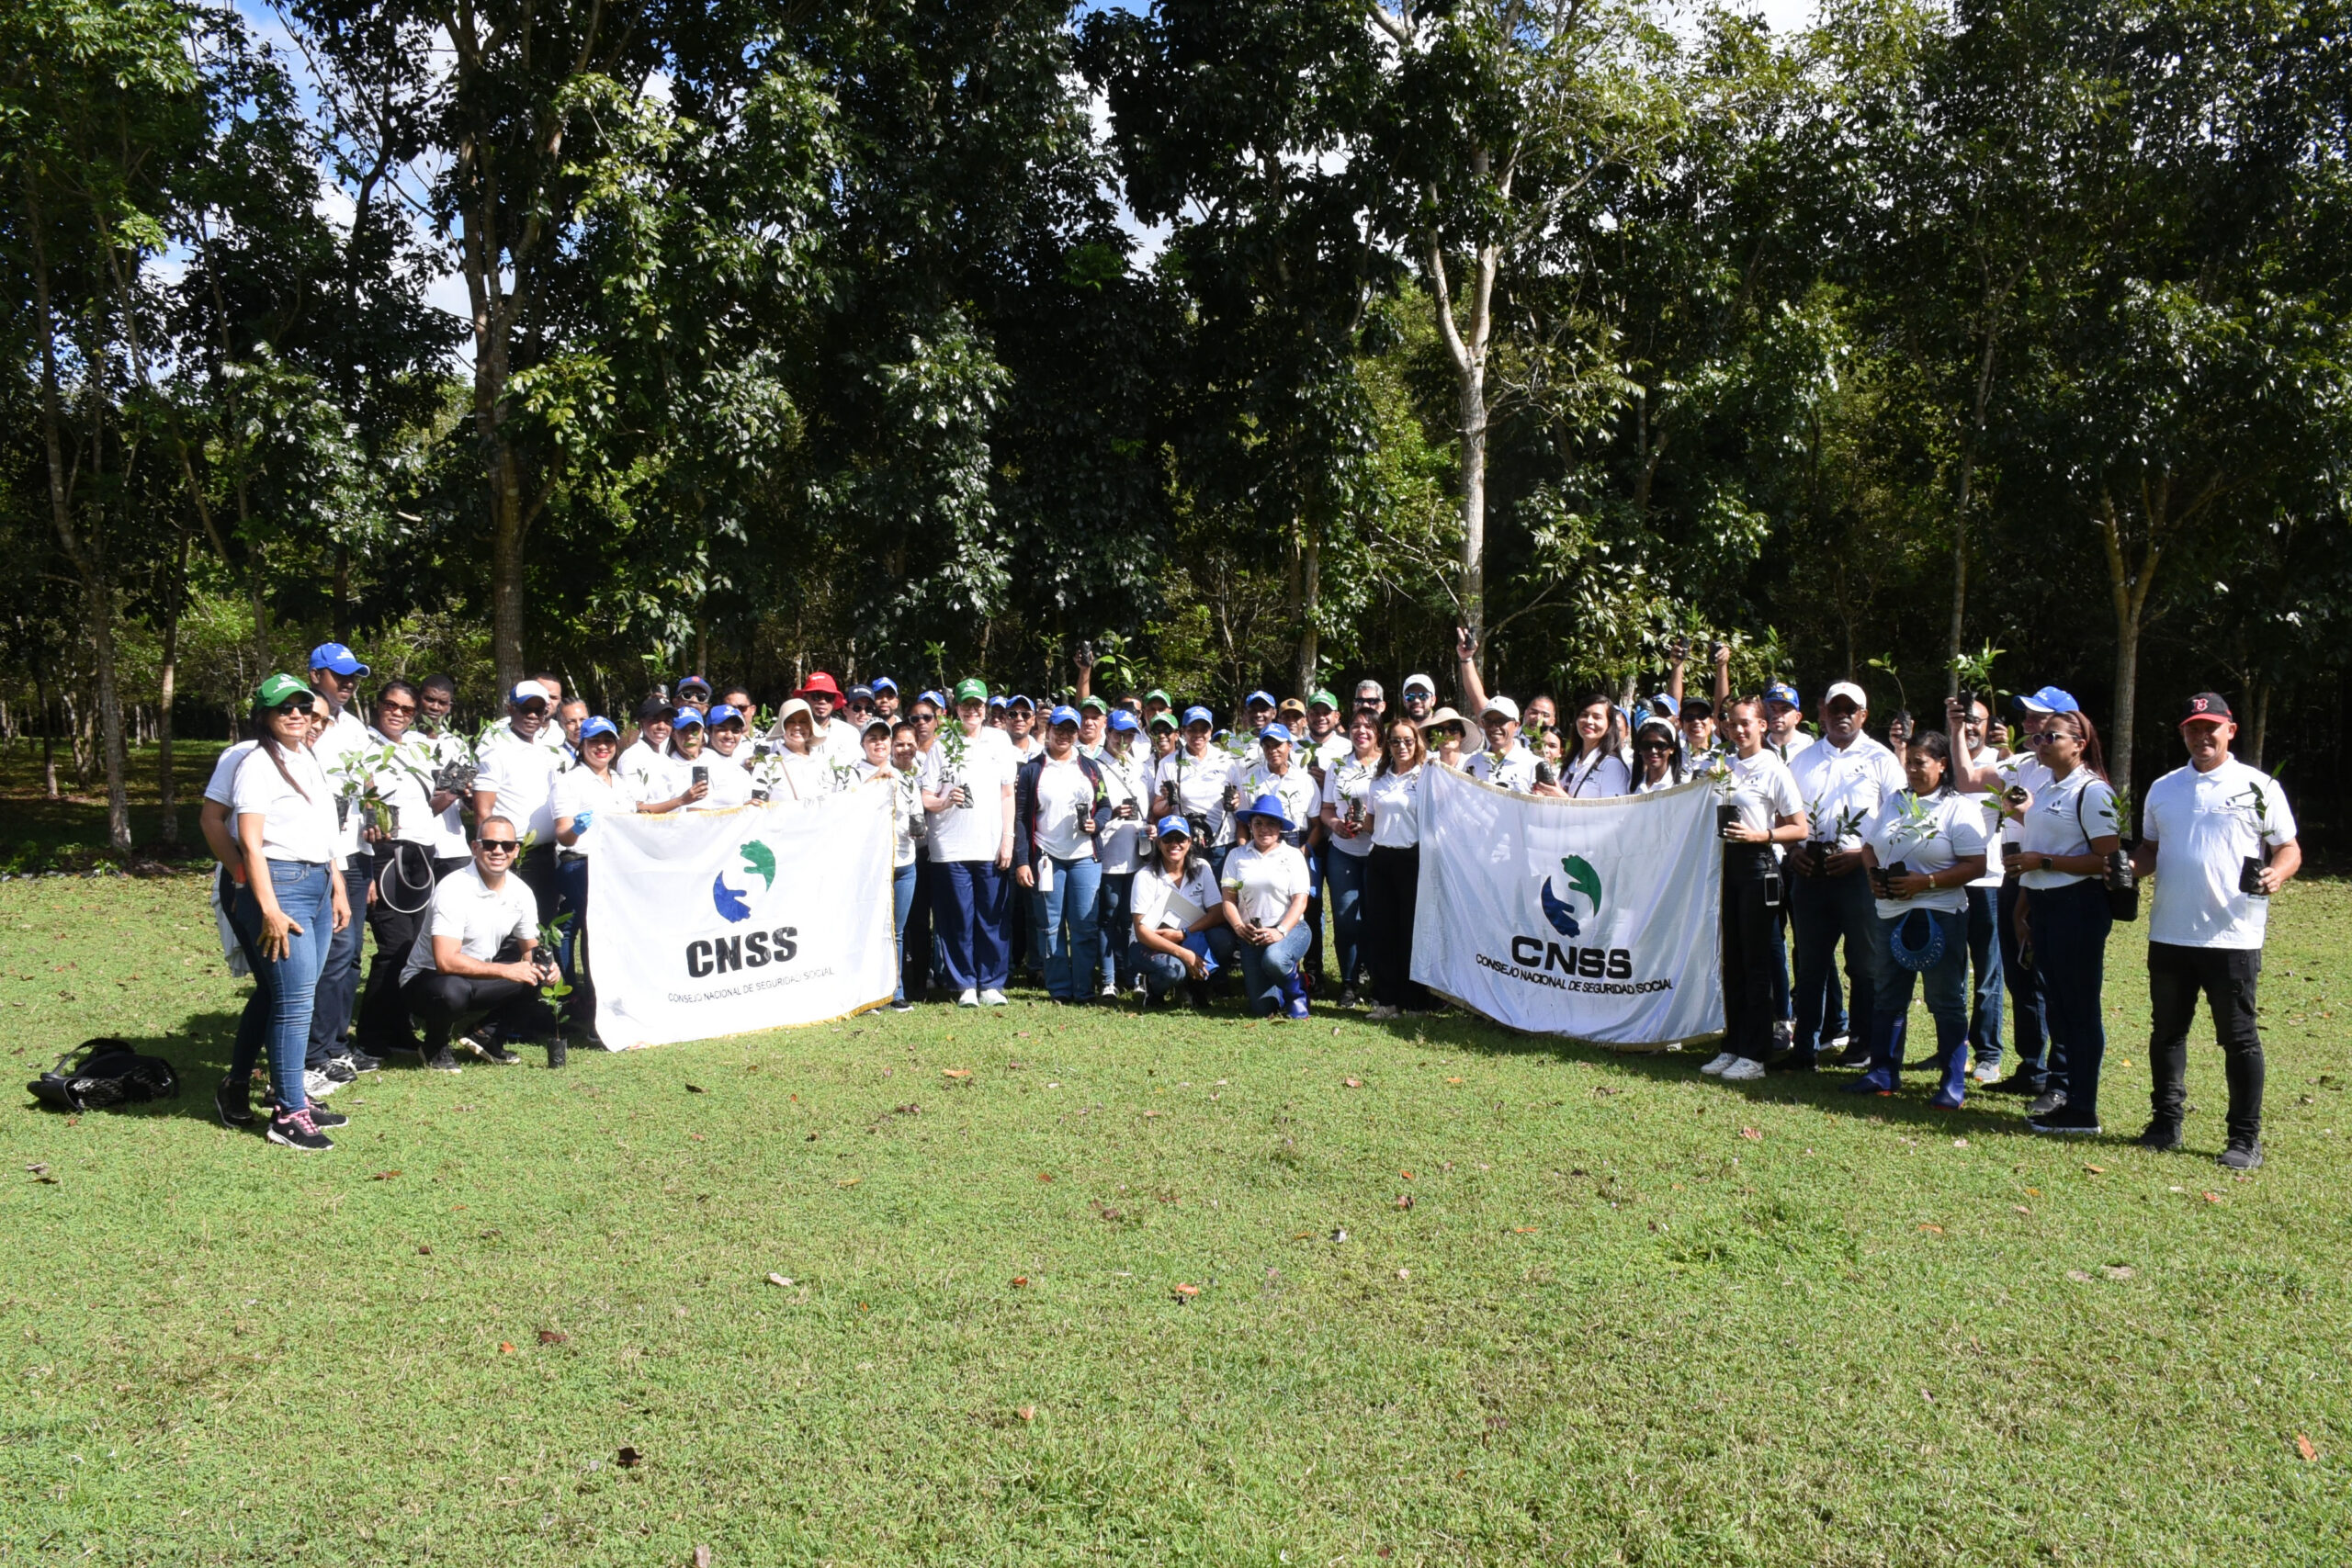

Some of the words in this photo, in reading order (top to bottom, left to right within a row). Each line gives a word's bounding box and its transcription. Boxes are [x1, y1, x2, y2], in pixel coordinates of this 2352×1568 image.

[686, 926, 797, 978] CNSS
[1511, 935, 1633, 979] CNSS
[668, 992, 703, 1004] CONSEJO
[704, 989, 741, 1001] NACIONAL
[742, 984, 753, 994] DE
[803, 966, 834, 980] SOCIAL
[1476, 953, 1519, 978] CONSEJO
[1520, 970, 1566, 990] NACIONAL
[1567, 980, 1580, 992] DE
[1582, 980, 1634, 995] SEGURIDAD
[1635, 978, 1673, 995] SOCIAL
